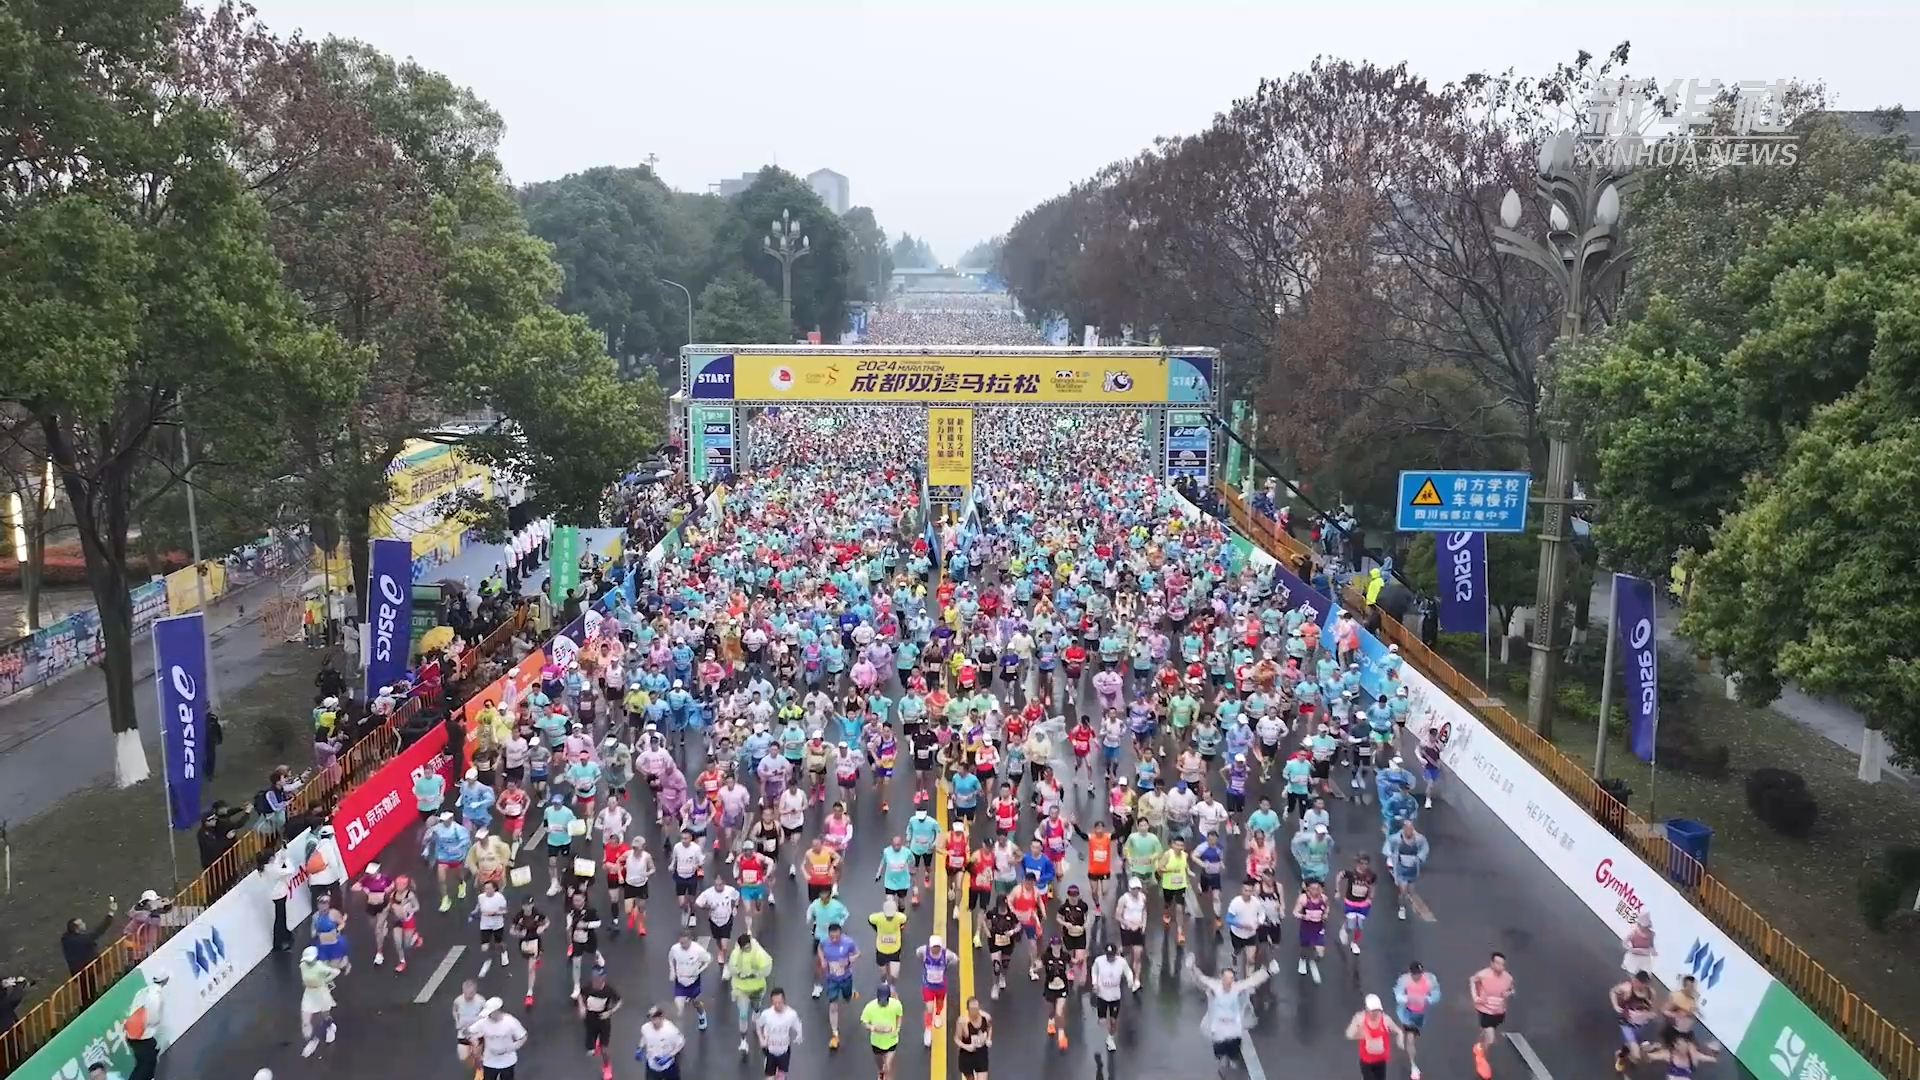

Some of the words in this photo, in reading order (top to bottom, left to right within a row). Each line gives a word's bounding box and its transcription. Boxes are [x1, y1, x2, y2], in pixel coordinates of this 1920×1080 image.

[698, 373, 731, 384] START
[850, 373, 1041, 393] 成都双遗马拉松
[856, 360, 897, 371] 2024
[1451, 493, 1518, 508] 车辆慢行
[1453, 478, 1520, 492] 前方学校
[1453, 549, 1473, 603] asics
[376, 602, 397, 663] asics
[178, 701, 196, 780] asics
[1472, 752, 1502, 786] HEYTEA
[345, 817, 371, 851] JDL
[364, 790, 402, 829] 京东物流
[1525, 800, 1560, 840] HEYTEA
[1595, 858, 1645, 914] GymMax
